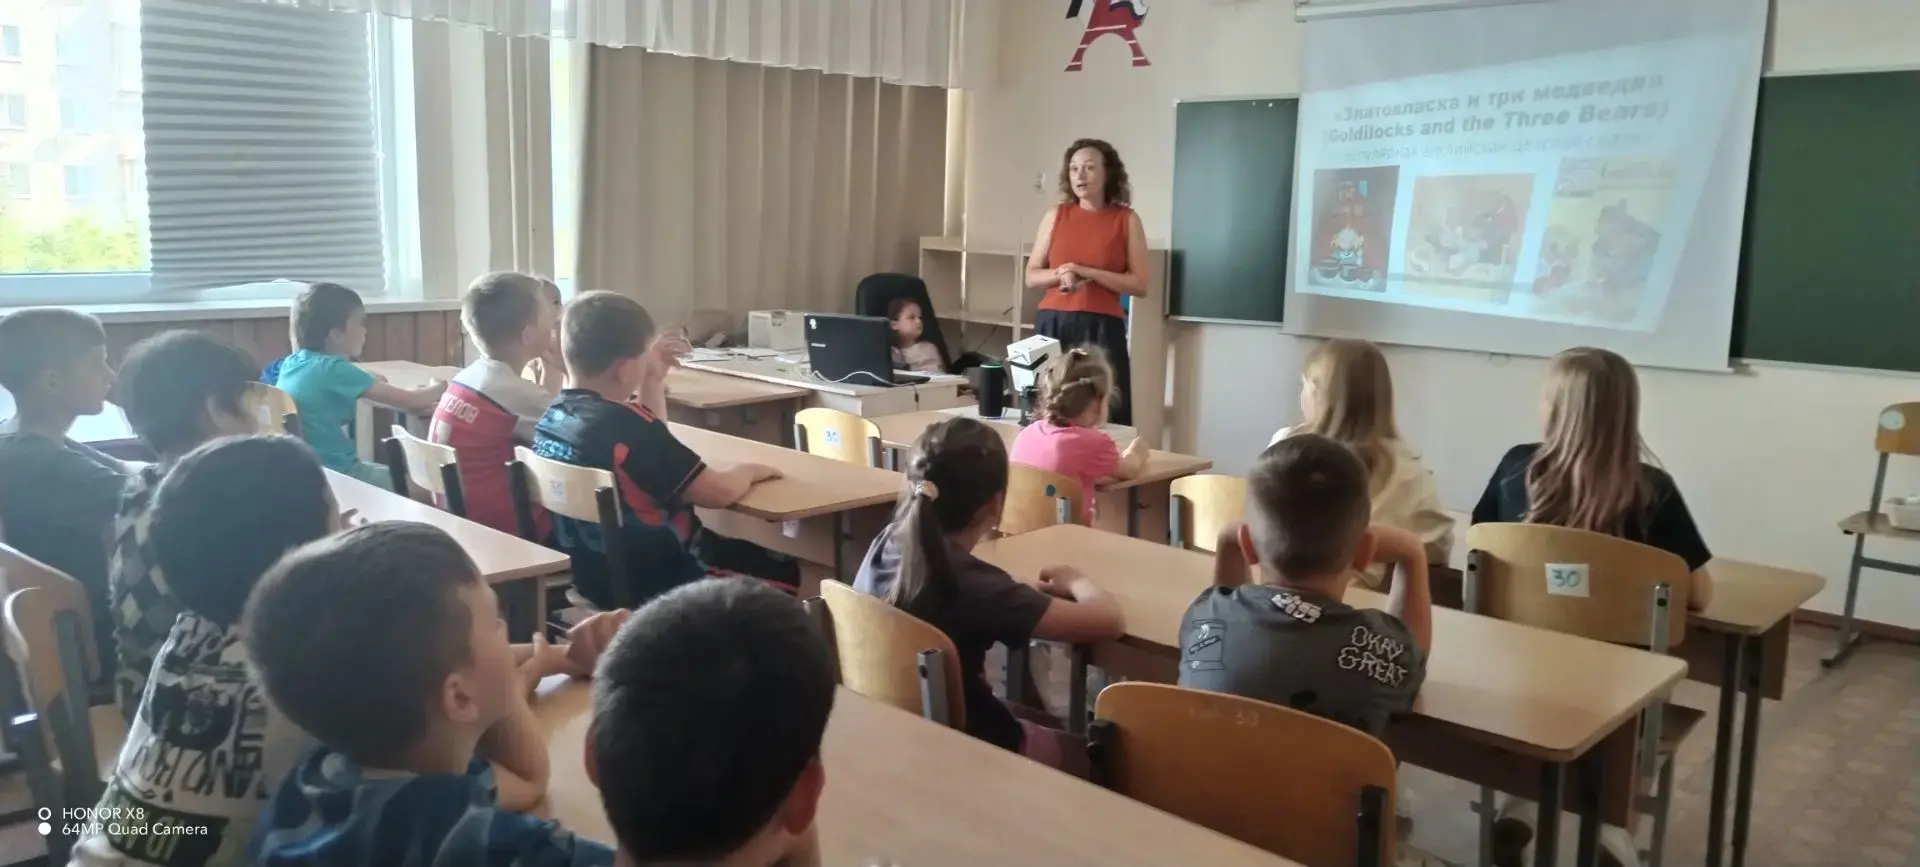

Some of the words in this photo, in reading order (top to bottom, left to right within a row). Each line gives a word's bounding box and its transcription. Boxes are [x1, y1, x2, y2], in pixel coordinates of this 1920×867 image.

[1467, 94, 1480, 108] и
[1488, 89, 1525, 108] три
[1420, 116, 1456, 136] and
[1462, 114, 1496, 132] the
[1504, 108, 1571, 129] Three
[1552, 568, 1581, 588] 30
[1351, 625, 1404, 661] OKAY
[1337, 646, 1410, 688] GREAT
